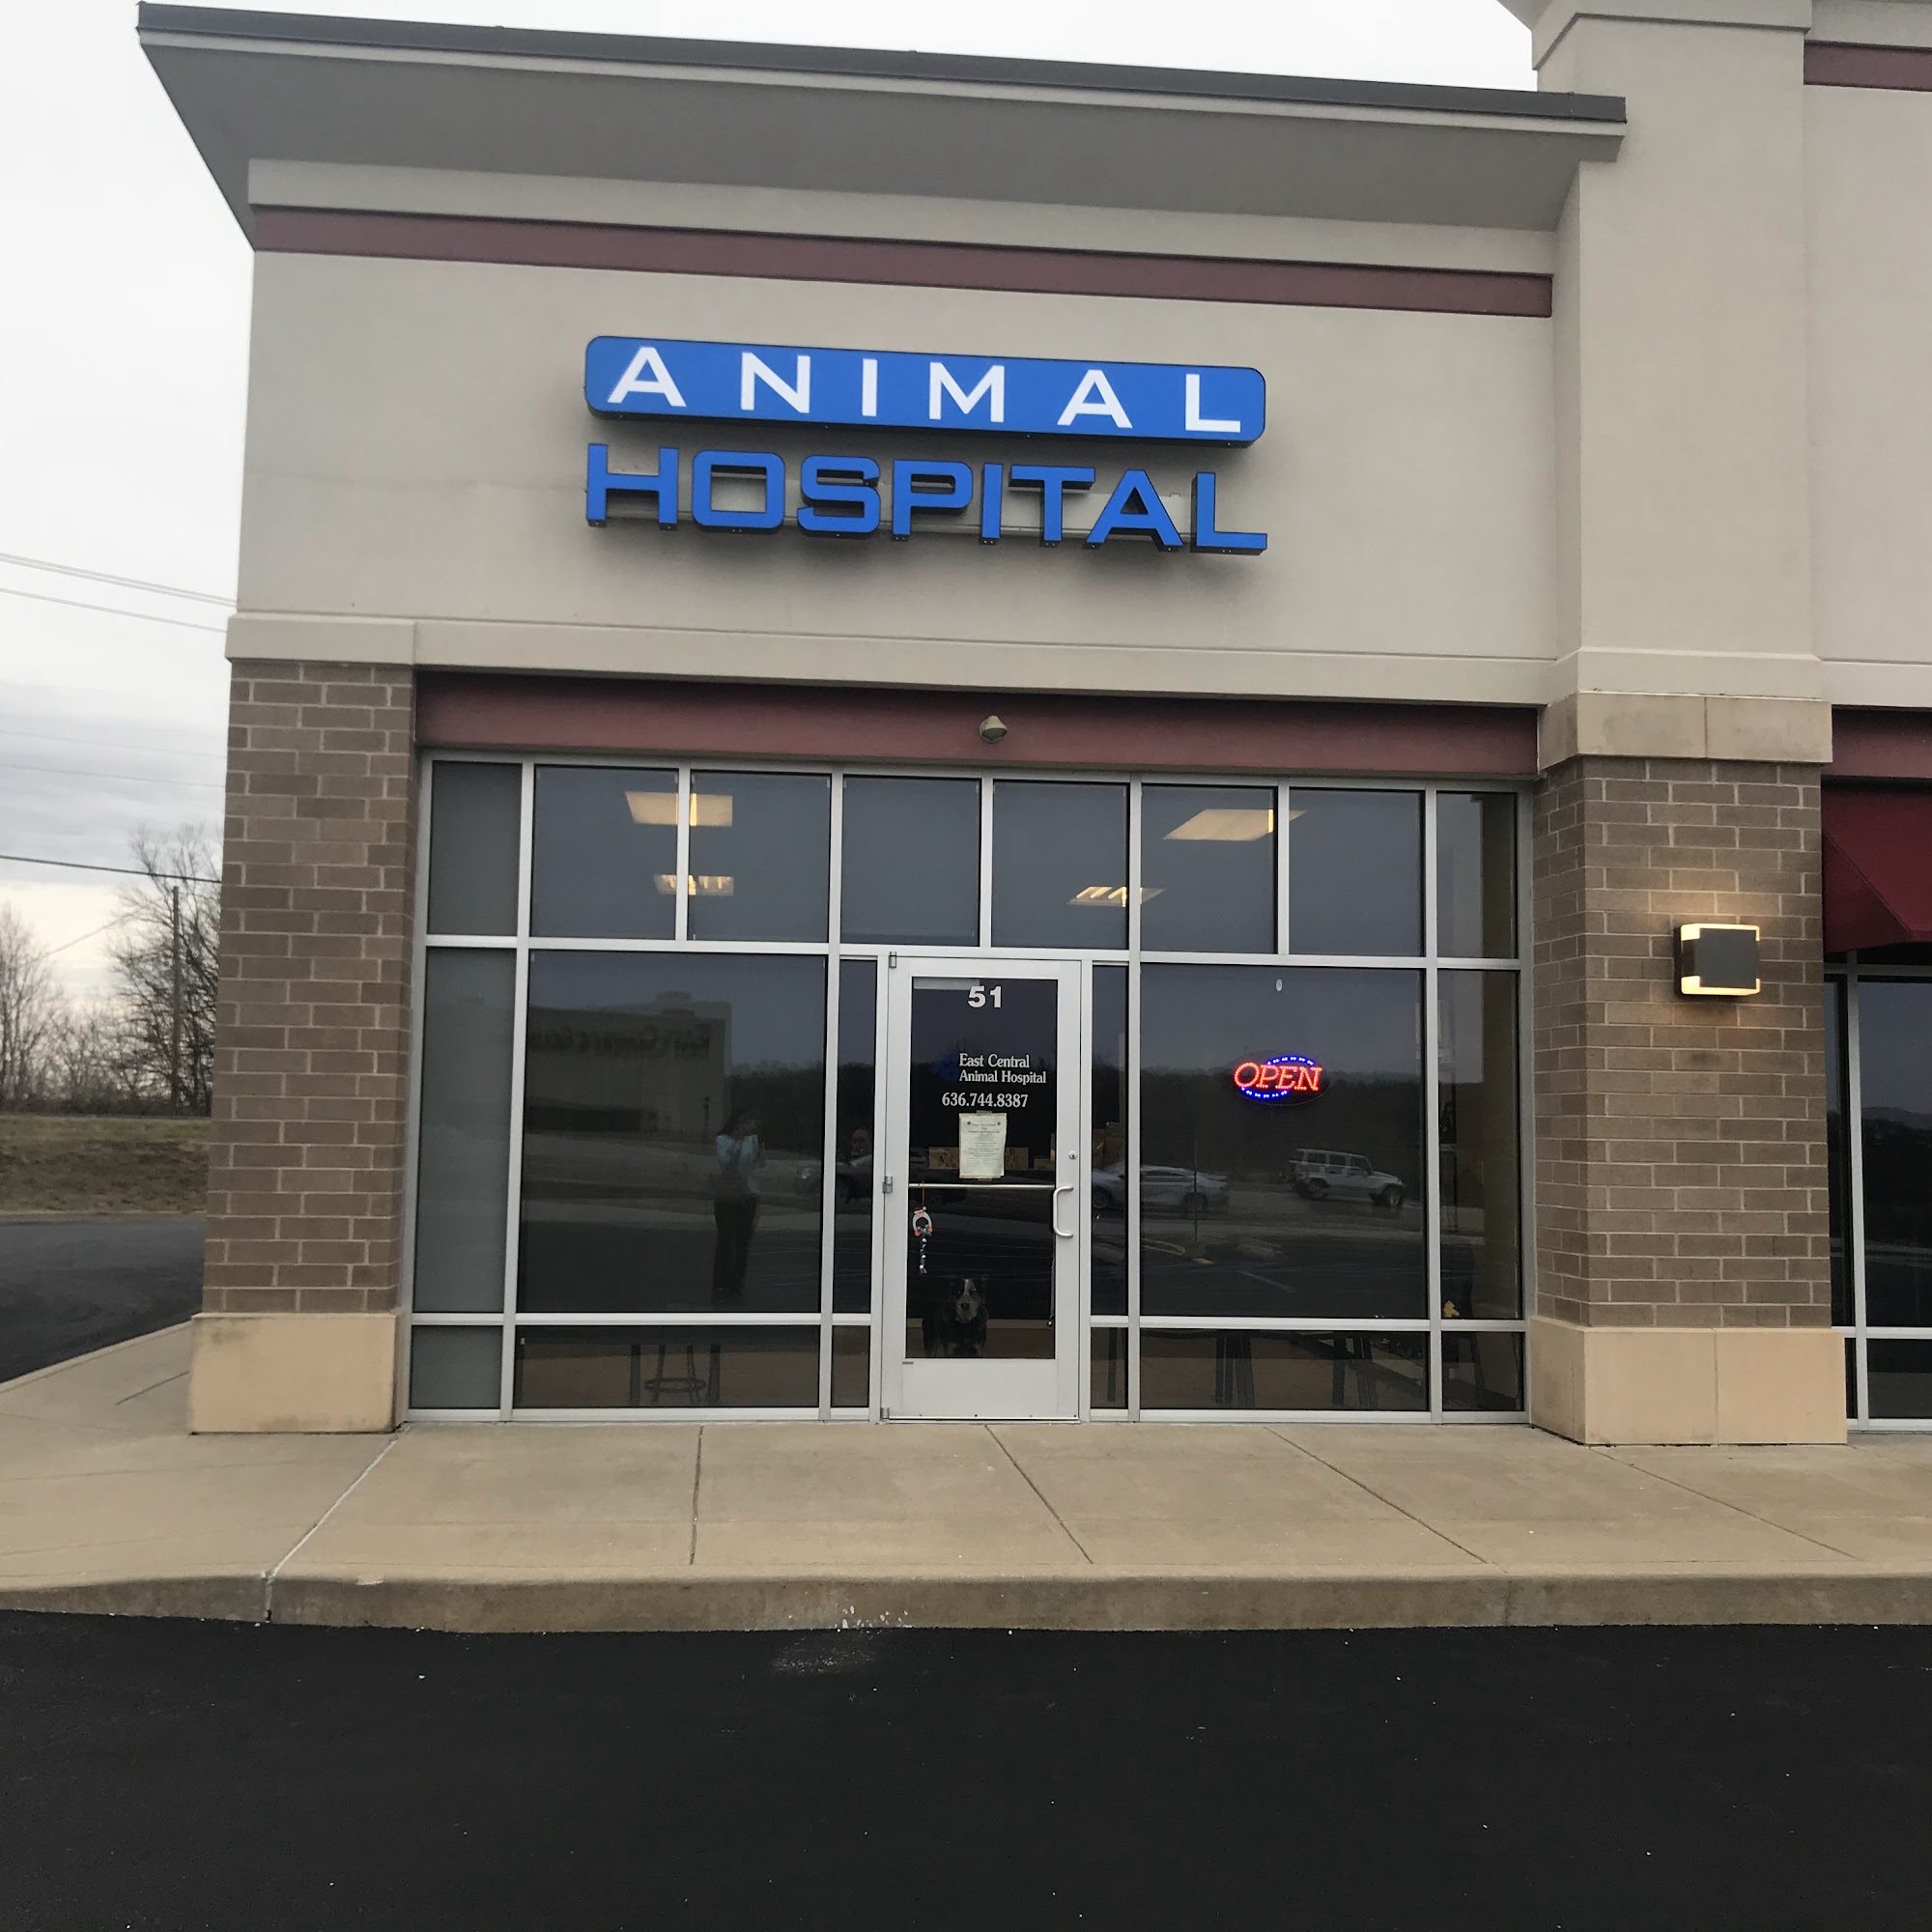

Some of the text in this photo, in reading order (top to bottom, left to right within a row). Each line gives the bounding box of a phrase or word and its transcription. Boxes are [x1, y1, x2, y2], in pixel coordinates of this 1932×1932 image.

[607, 346, 1241, 433] ANIMAL
[586, 442, 1268, 552] HOSPITAL
[967, 985, 1002, 1008] 51
[959, 1053, 1030, 1067] East Central
[959, 1069, 1046, 1085] Animal Hospital
[1233, 1061, 1323, 1092] OPEN
[942, 1092, 1029, 1107] 636.744.8387
